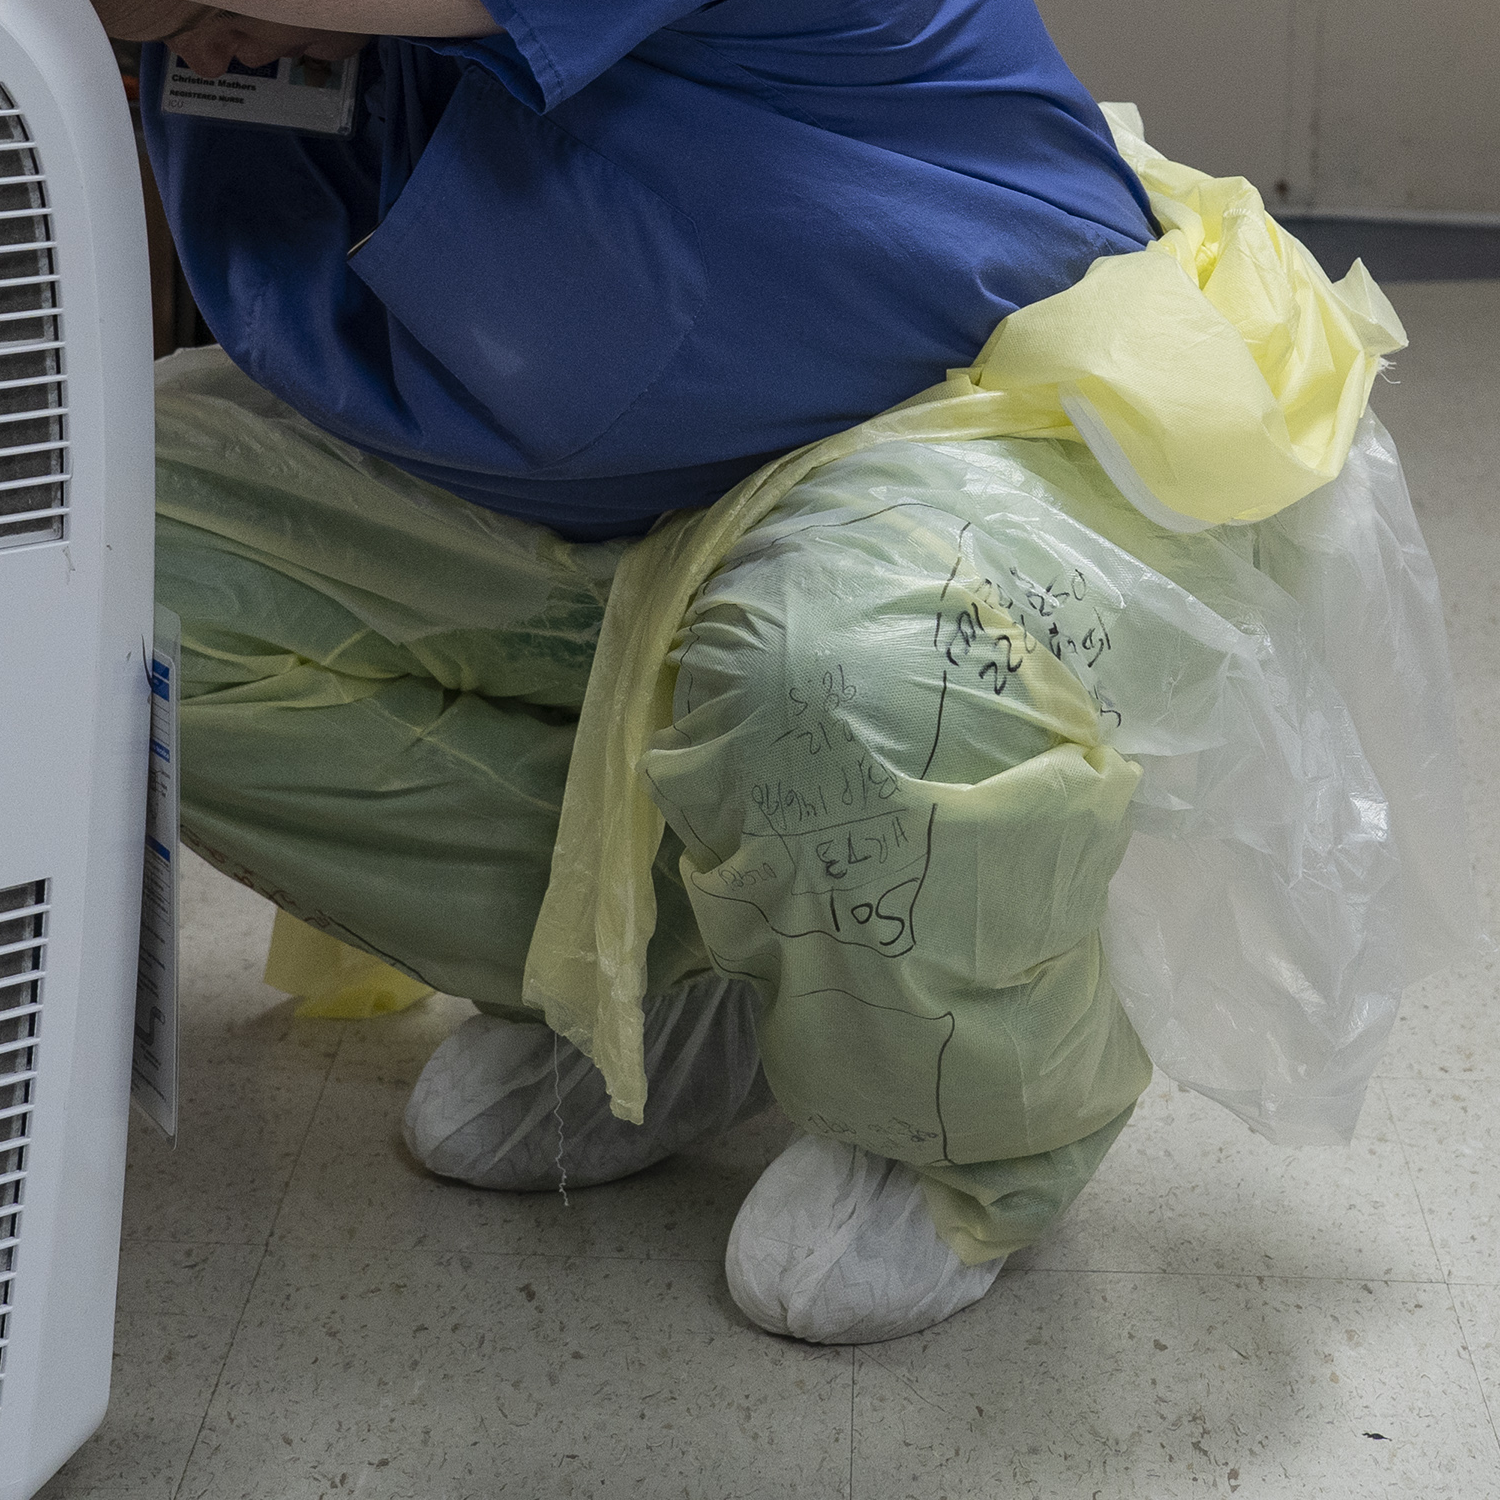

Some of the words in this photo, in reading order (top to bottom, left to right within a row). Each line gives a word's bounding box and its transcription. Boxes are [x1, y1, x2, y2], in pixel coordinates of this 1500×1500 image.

[171, 74, 216, 87] Christina
[217, 79, 257, 91] Mathers
[169, 89, 217, 101] REGISTERED
[218, 95, 244, 104] NURSE
